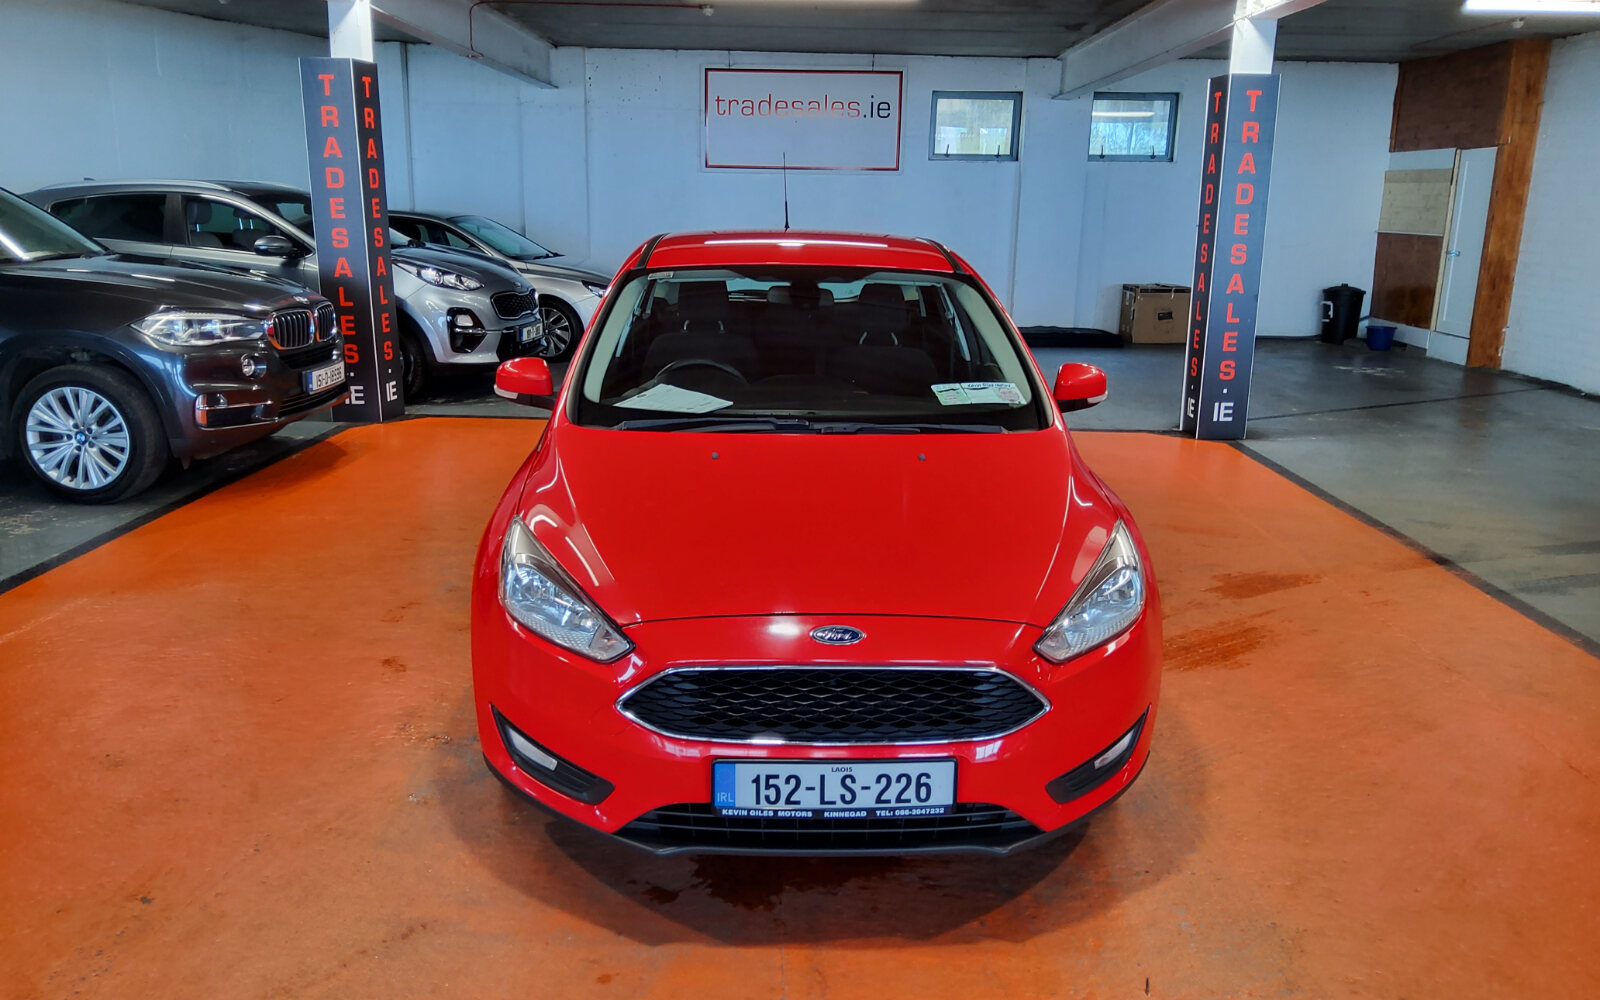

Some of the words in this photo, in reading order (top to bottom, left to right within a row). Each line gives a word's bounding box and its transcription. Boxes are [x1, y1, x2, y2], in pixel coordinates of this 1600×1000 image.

[715, 93, 891, 119] tradesales.ie
[318, 74, 365, 405] TRADESALES.E
[717, 791, 734, 803] IRL
[751, 772, 932, 806] 152-LS-226
[722, 808, 748, 816] KEVIN
[749, 809, 774, 817] GILES
[778, 810, 813, 818] MOTORS
[824, 810, 867, 818] KINNEGAD
[876, 809, 894, 817] TEL:
